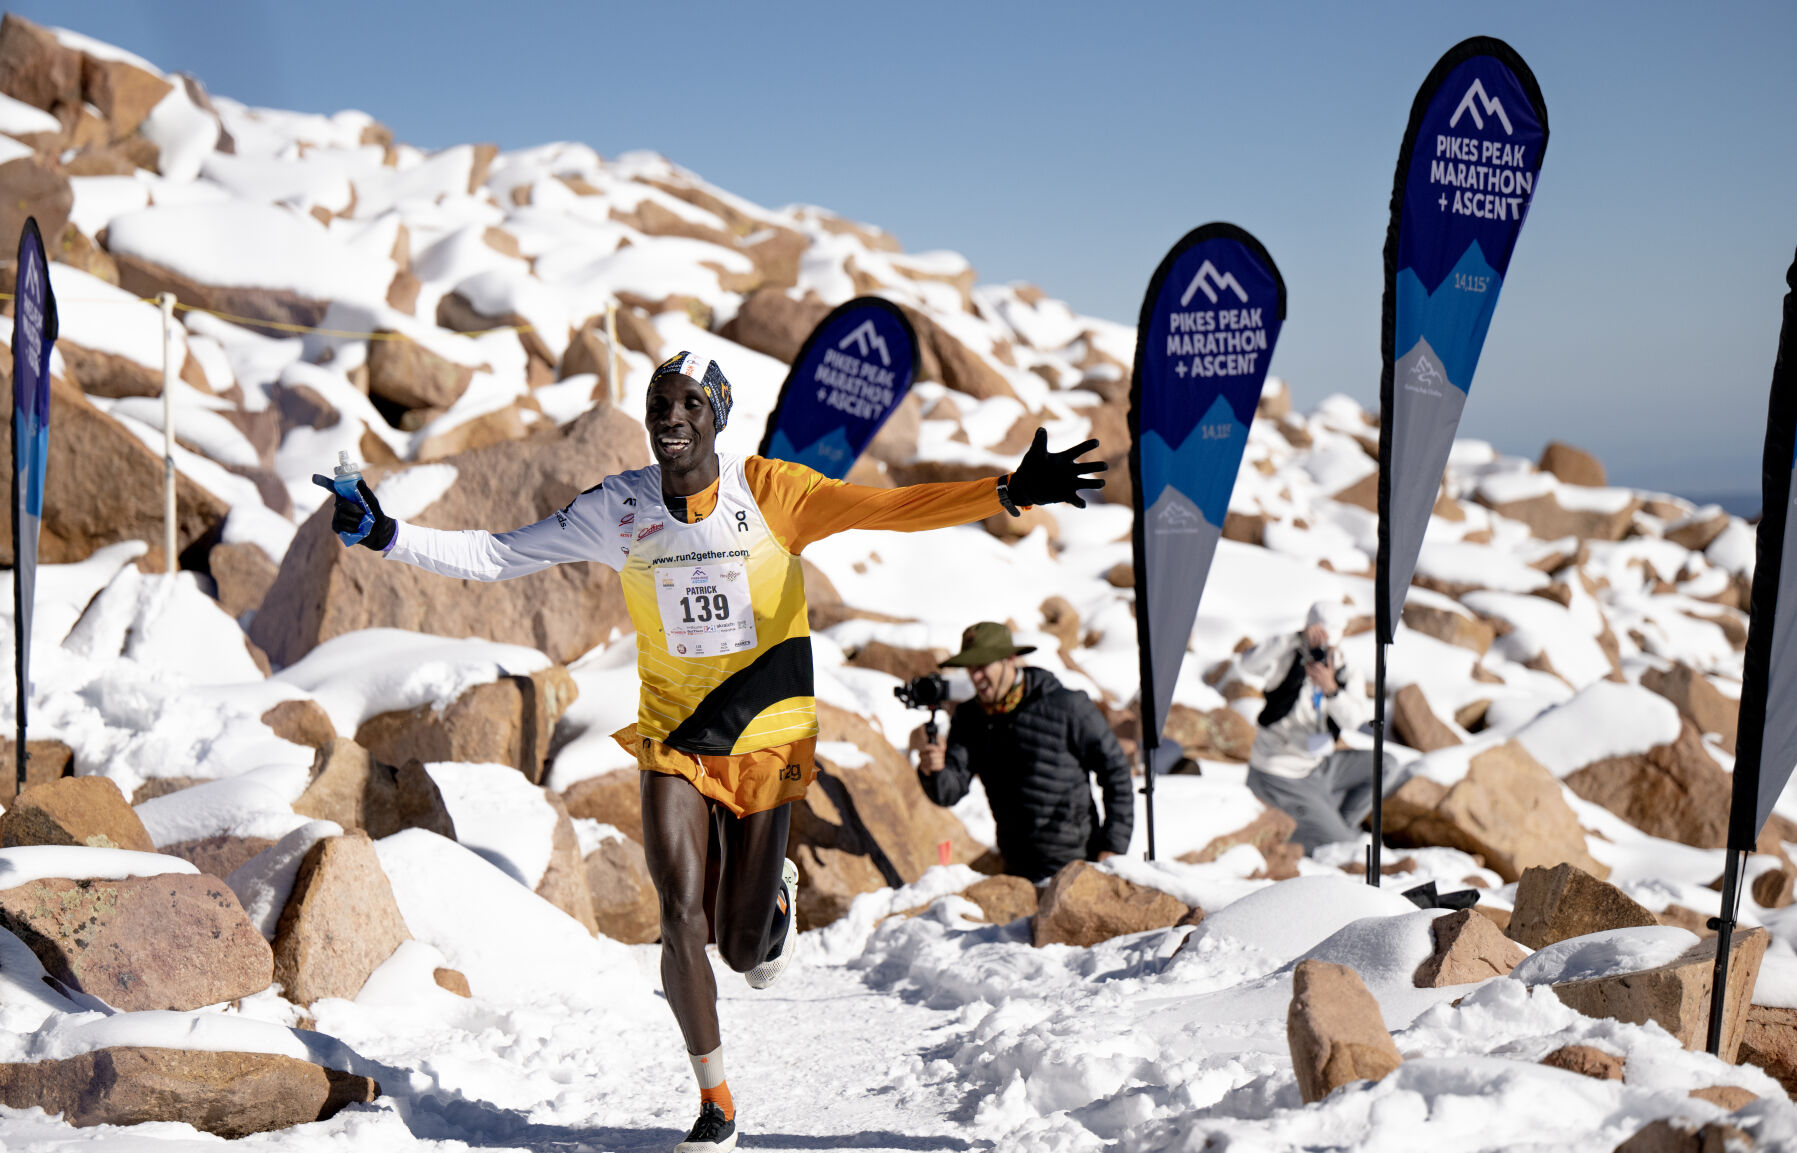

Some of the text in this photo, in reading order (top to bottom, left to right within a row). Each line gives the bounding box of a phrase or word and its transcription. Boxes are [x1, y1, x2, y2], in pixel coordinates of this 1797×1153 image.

[1437, 135, 1526, 168] PIKES PEAK
[1430, 159, 1533, 195] MARATHON
[1452, 190, 1523, 221] ASCENT
[1170, 307, 1262, 333] PIKES PEAK
[1166, 329, 1267, 356] MARATHON
[823, 348, 895, 389] PIKES PEAK
[1191, 352, 1258, 378] ASCENT
[814, 364, 895, 408] MARATHON
[826, 390, 883, 420] ASCENT
[652, 550, 749, 565] www.run2gether.com
[685, 585, 718, 596] PATRICK
[680, 593, 730, 623] 139
[778, 763, 802, 781] r2g
